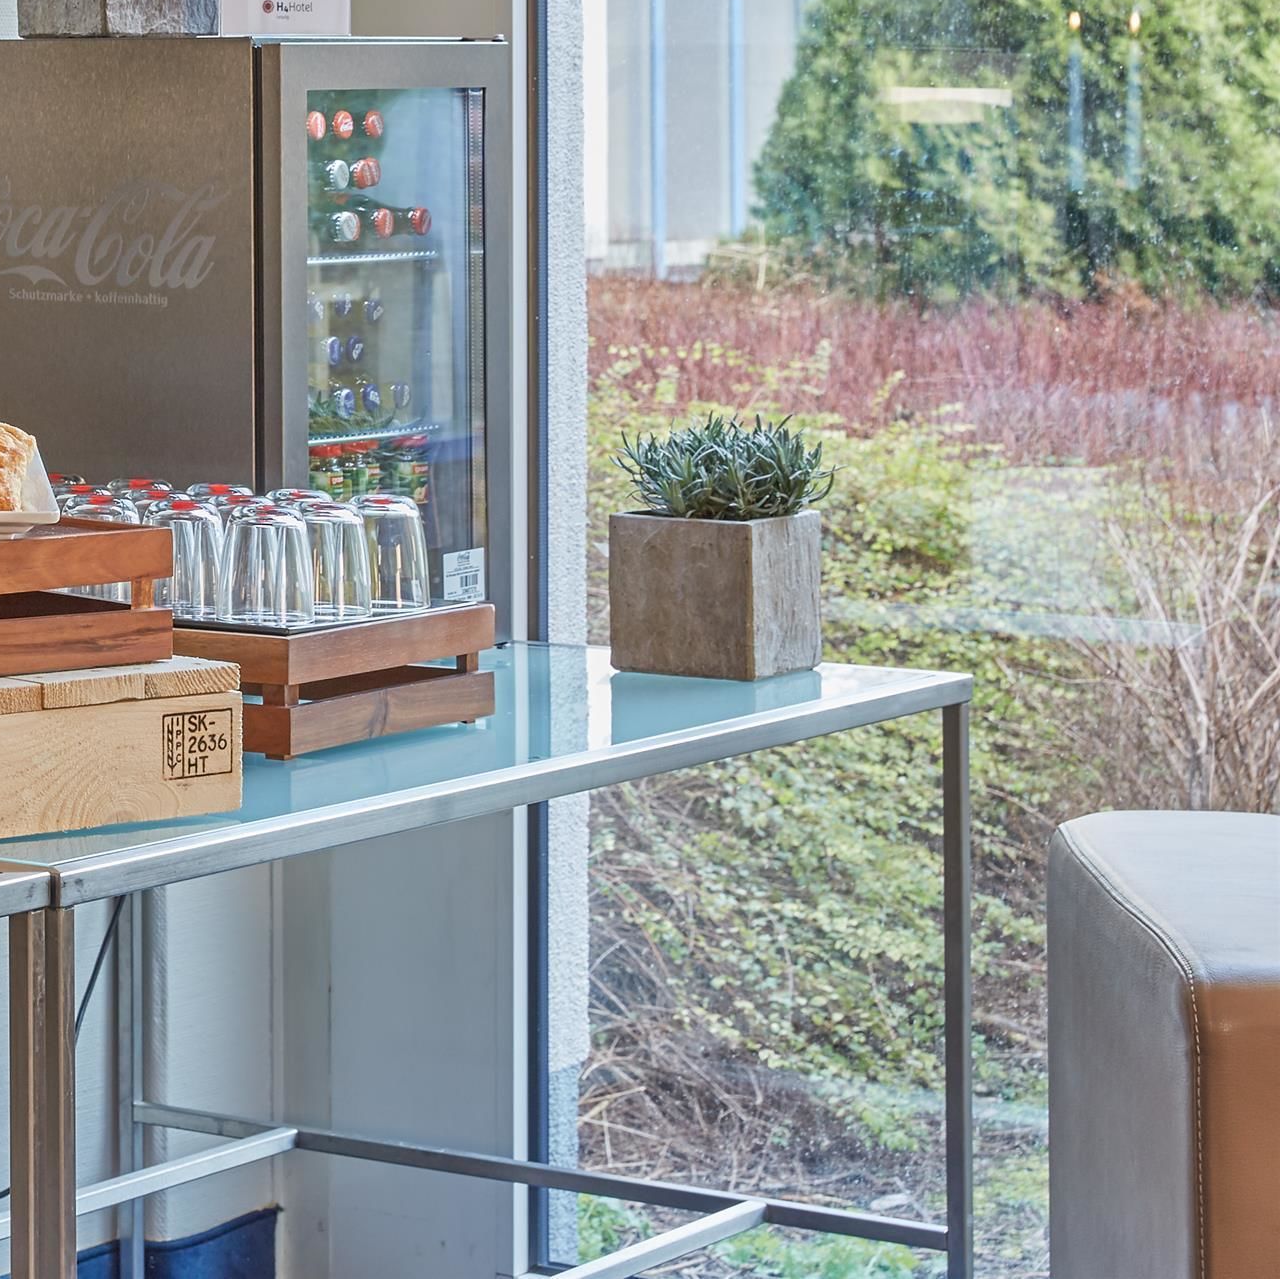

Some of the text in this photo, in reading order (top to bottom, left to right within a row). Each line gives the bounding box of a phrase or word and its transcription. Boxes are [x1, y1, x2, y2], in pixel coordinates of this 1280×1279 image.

[8, 287, 169, 308] Schutzmarke koffeinhaltig
[188, 714, 216, 733] SK-
[188, 733, 228, 754] 2636
[188, 755, 209, 774] HT
